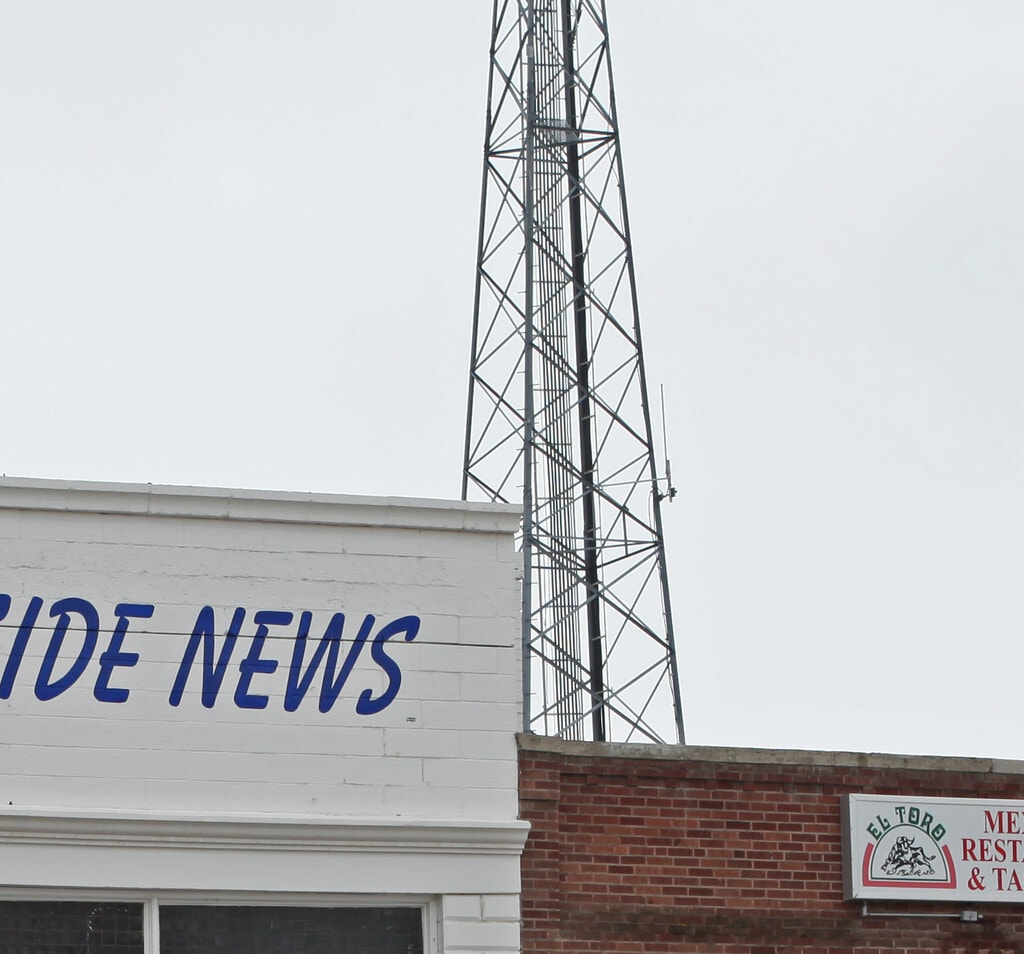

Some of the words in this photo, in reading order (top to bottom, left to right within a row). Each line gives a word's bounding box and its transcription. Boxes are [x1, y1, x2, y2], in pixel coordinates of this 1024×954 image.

[168, 605, 420, 715] NEWS
[866, 814, 891, 841] EL
[894, 806, 946, 841] TORO
[983, 810, 1024, 834] ME
[960, 838, 1024, 862] REST
[967, 866, 986, 891] &
